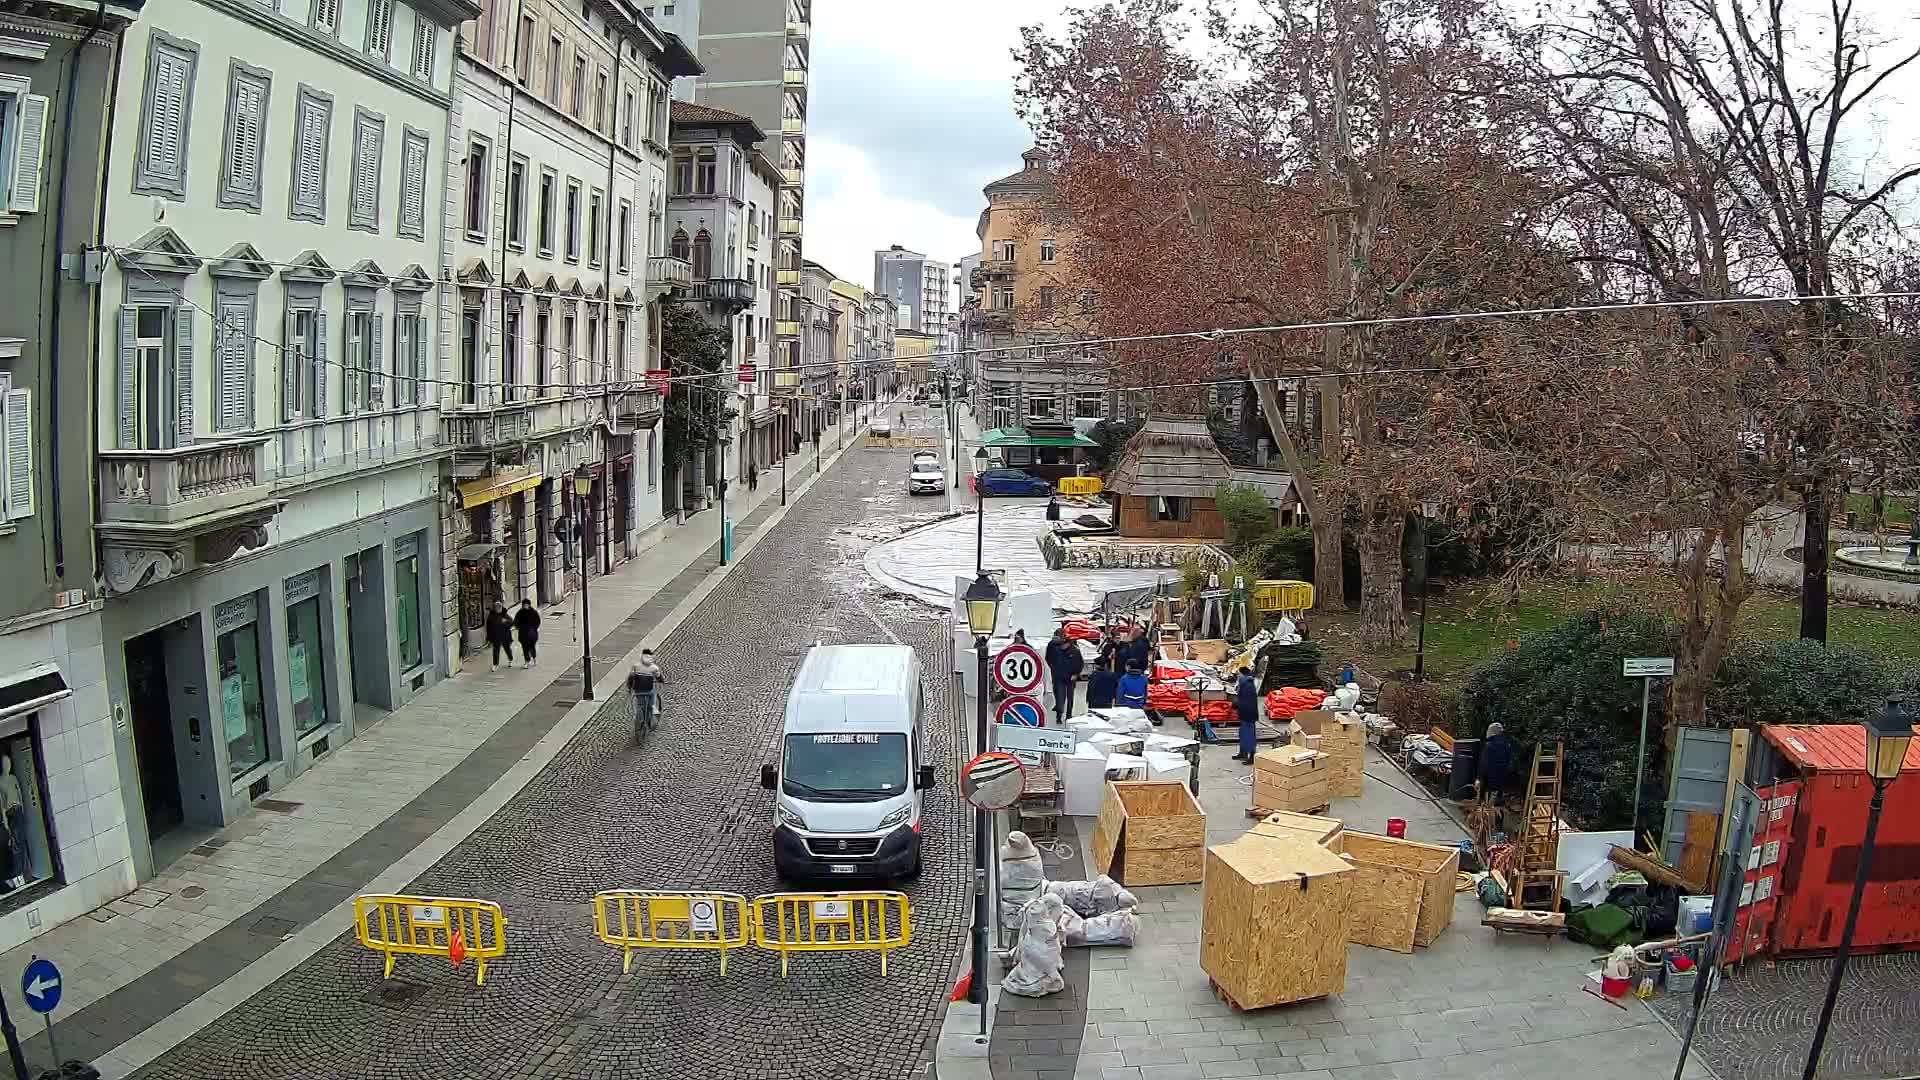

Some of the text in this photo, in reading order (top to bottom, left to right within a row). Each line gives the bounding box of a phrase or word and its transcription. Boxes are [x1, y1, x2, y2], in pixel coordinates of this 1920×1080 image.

[1006, 658, 1033, 680] 30
[813, 733, 879, 744] PROTEZIONE CIVILE
[1038, 738, 1070, 749] Dante
